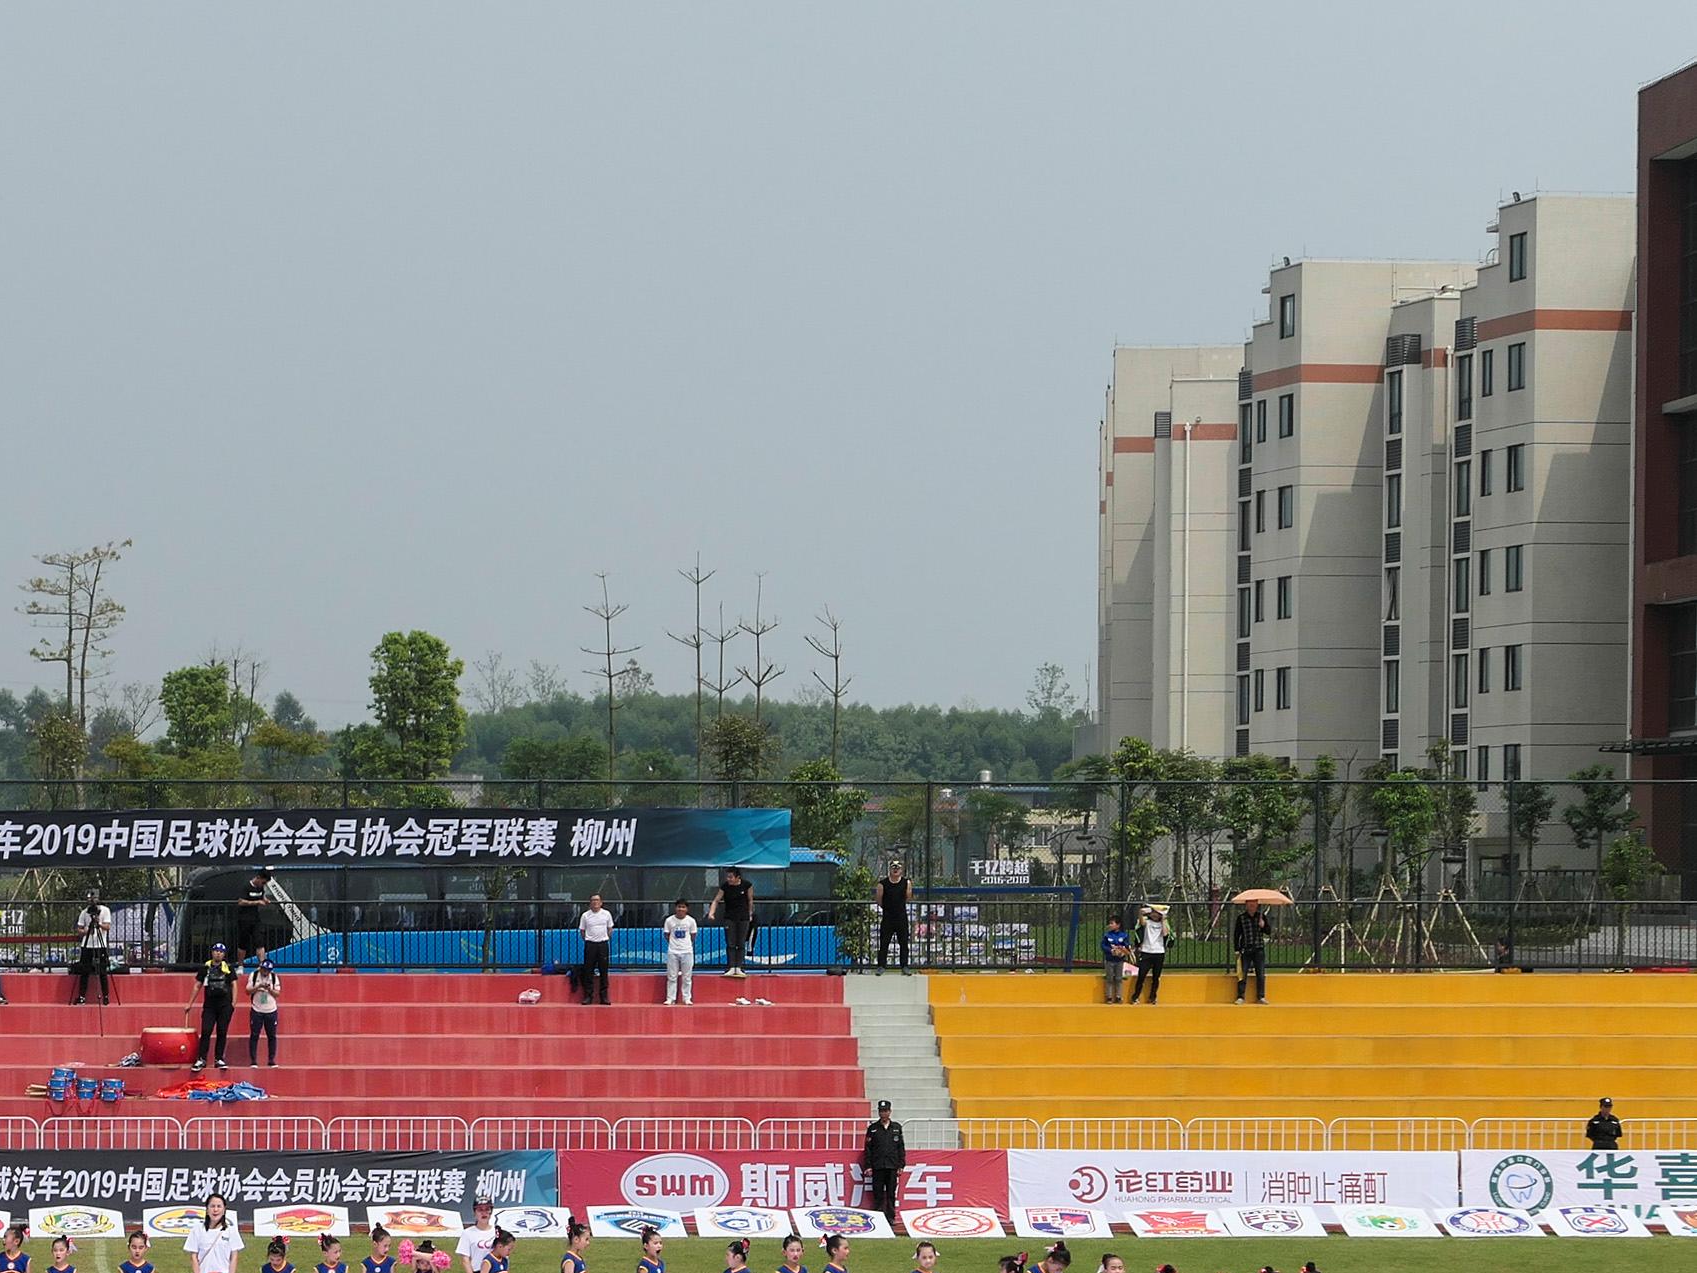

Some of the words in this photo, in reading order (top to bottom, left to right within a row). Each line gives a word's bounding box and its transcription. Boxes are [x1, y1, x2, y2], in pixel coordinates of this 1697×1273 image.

[570, 818, 638, 859] 柳州
[475, 1169, 527, 1203] 柳州
[635, 1175, 716, 1198] SWM
[740, 1162, 954, 1209] 斯威车
[1114, 1168, 1233, 1193] 花红药业
[1261, 1171, 1388, 1205] 消肿止痛酊
[1114, 1196, 1155, 1204] HUAHONG
[1158, 1196, 1232, 1204] PHARMACEUTICAL
